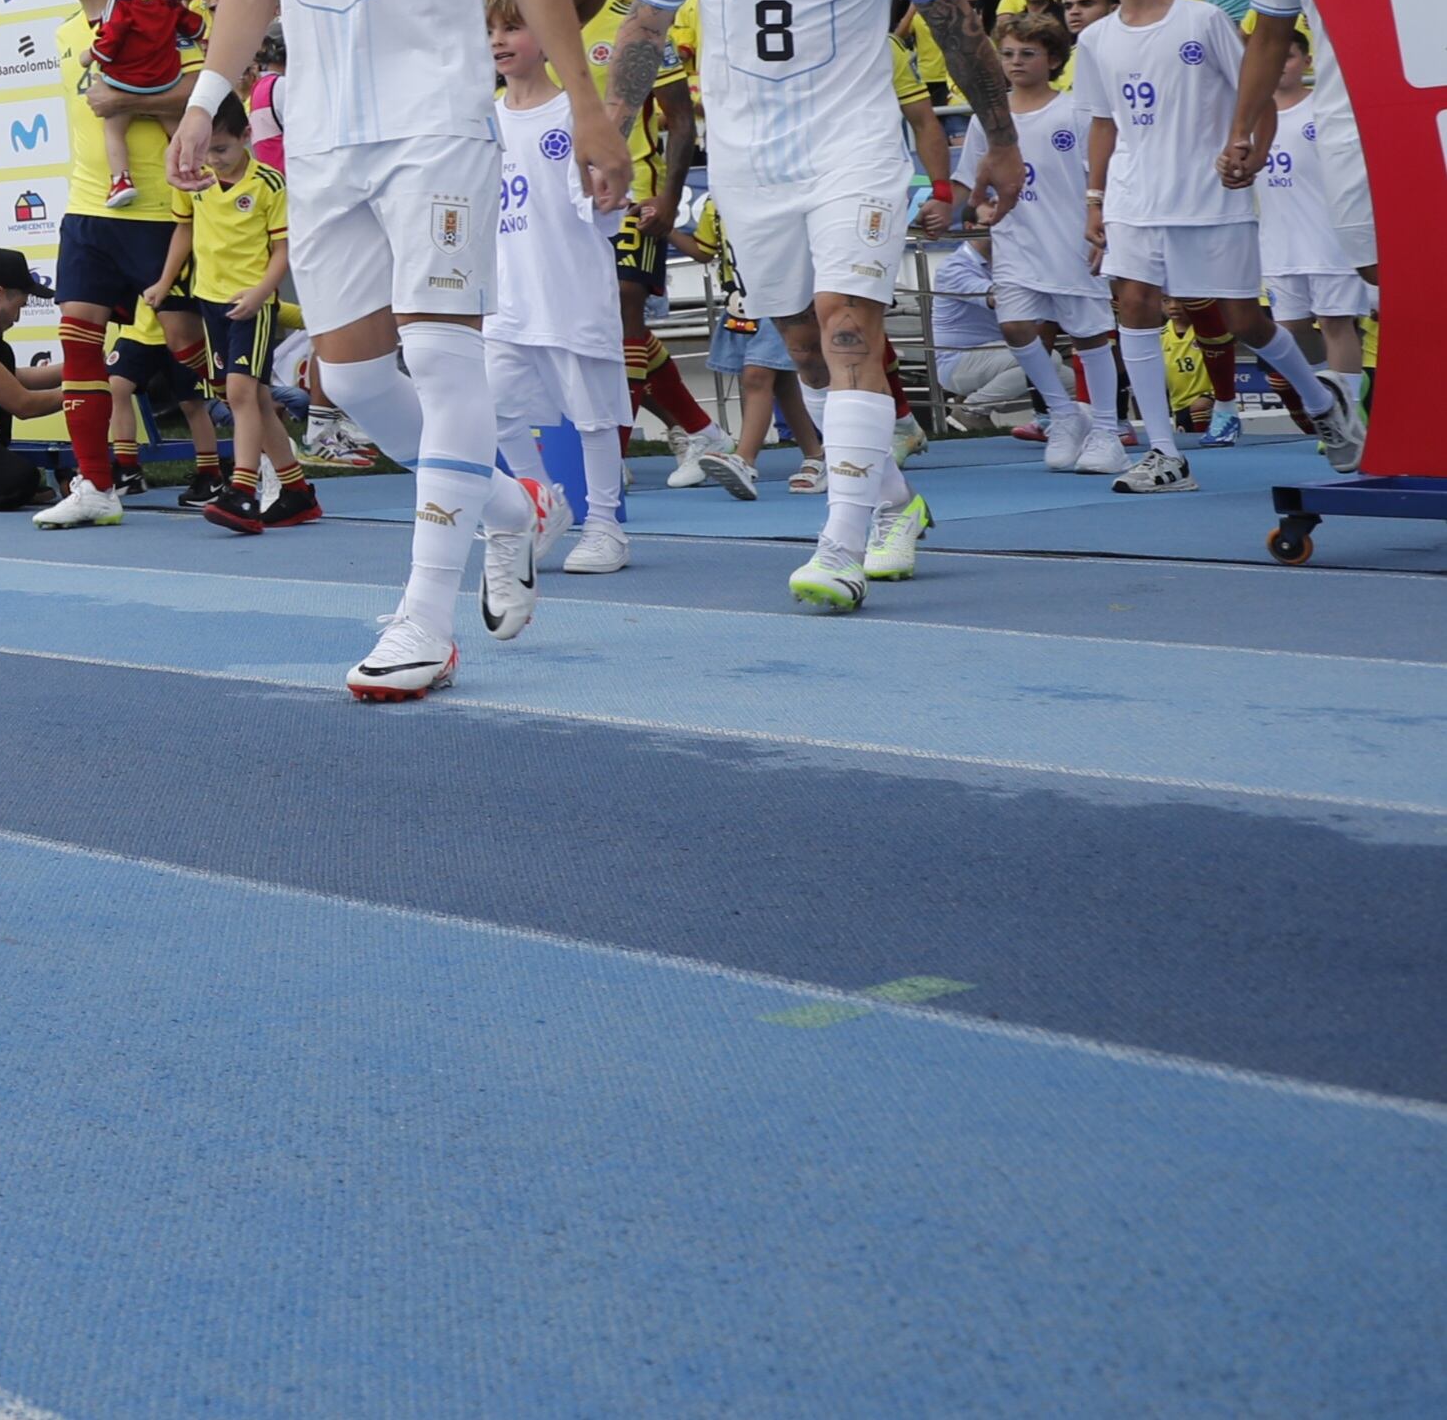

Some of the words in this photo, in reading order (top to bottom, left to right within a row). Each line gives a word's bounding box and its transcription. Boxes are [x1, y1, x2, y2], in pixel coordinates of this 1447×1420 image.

[756, 0, 794, 61] 8
[1122, 81, 1155, 109] 99
[429, 276, 464, 289] PUMA
[1176, 356, 1195, 373] 18
